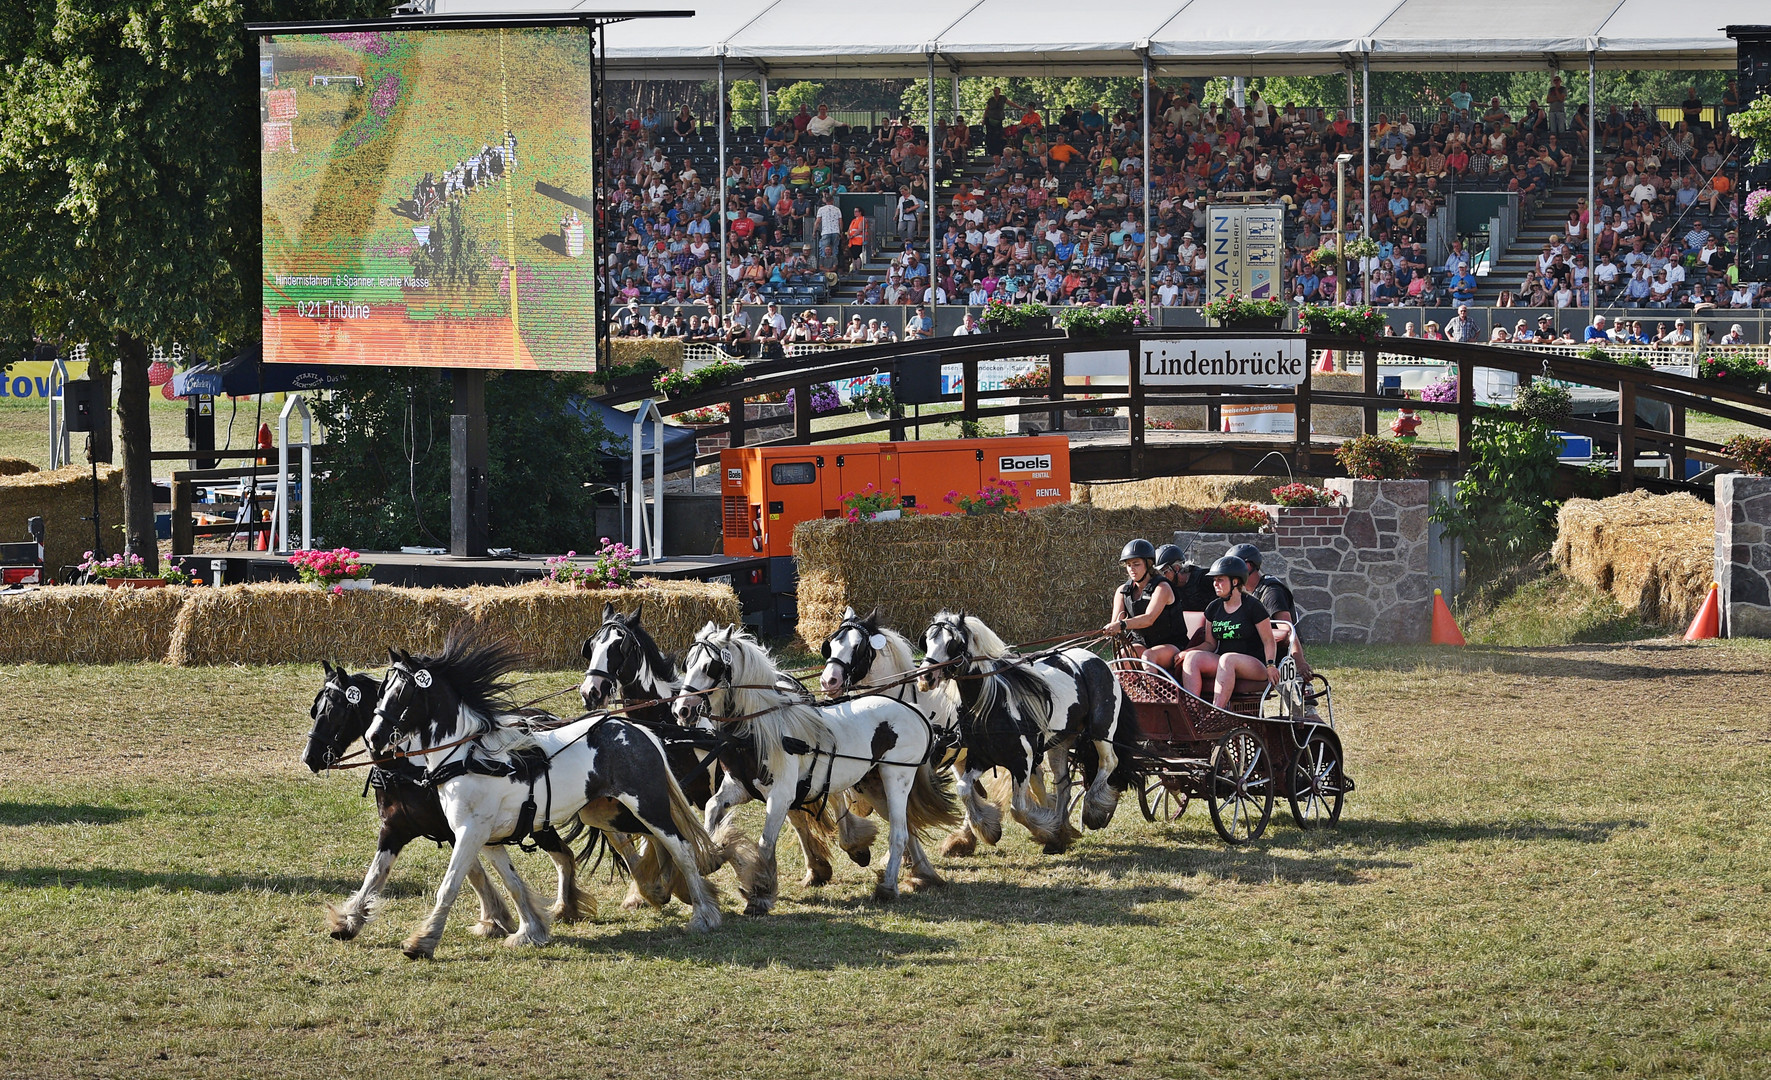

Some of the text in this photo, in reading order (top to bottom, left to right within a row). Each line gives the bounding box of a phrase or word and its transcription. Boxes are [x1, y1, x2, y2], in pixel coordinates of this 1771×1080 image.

[1214, 216, 1229, 298] MANN
[275, 274, 429, 288] Hindernisfahren, 6-Spänner, leichte Klasse
[297, 300, 370, 319] 0:21 Tribüne
[1143, 349, 1302, 376] Lindenbrücke
[1001, 456, 1050, 470] Boels
[728, 470, 741, 479] Boels
[1035, 488, 1062, 498] RENTAL
[415, 670, 431, 686] 254
[1280, 661, 1295, 683] 106
